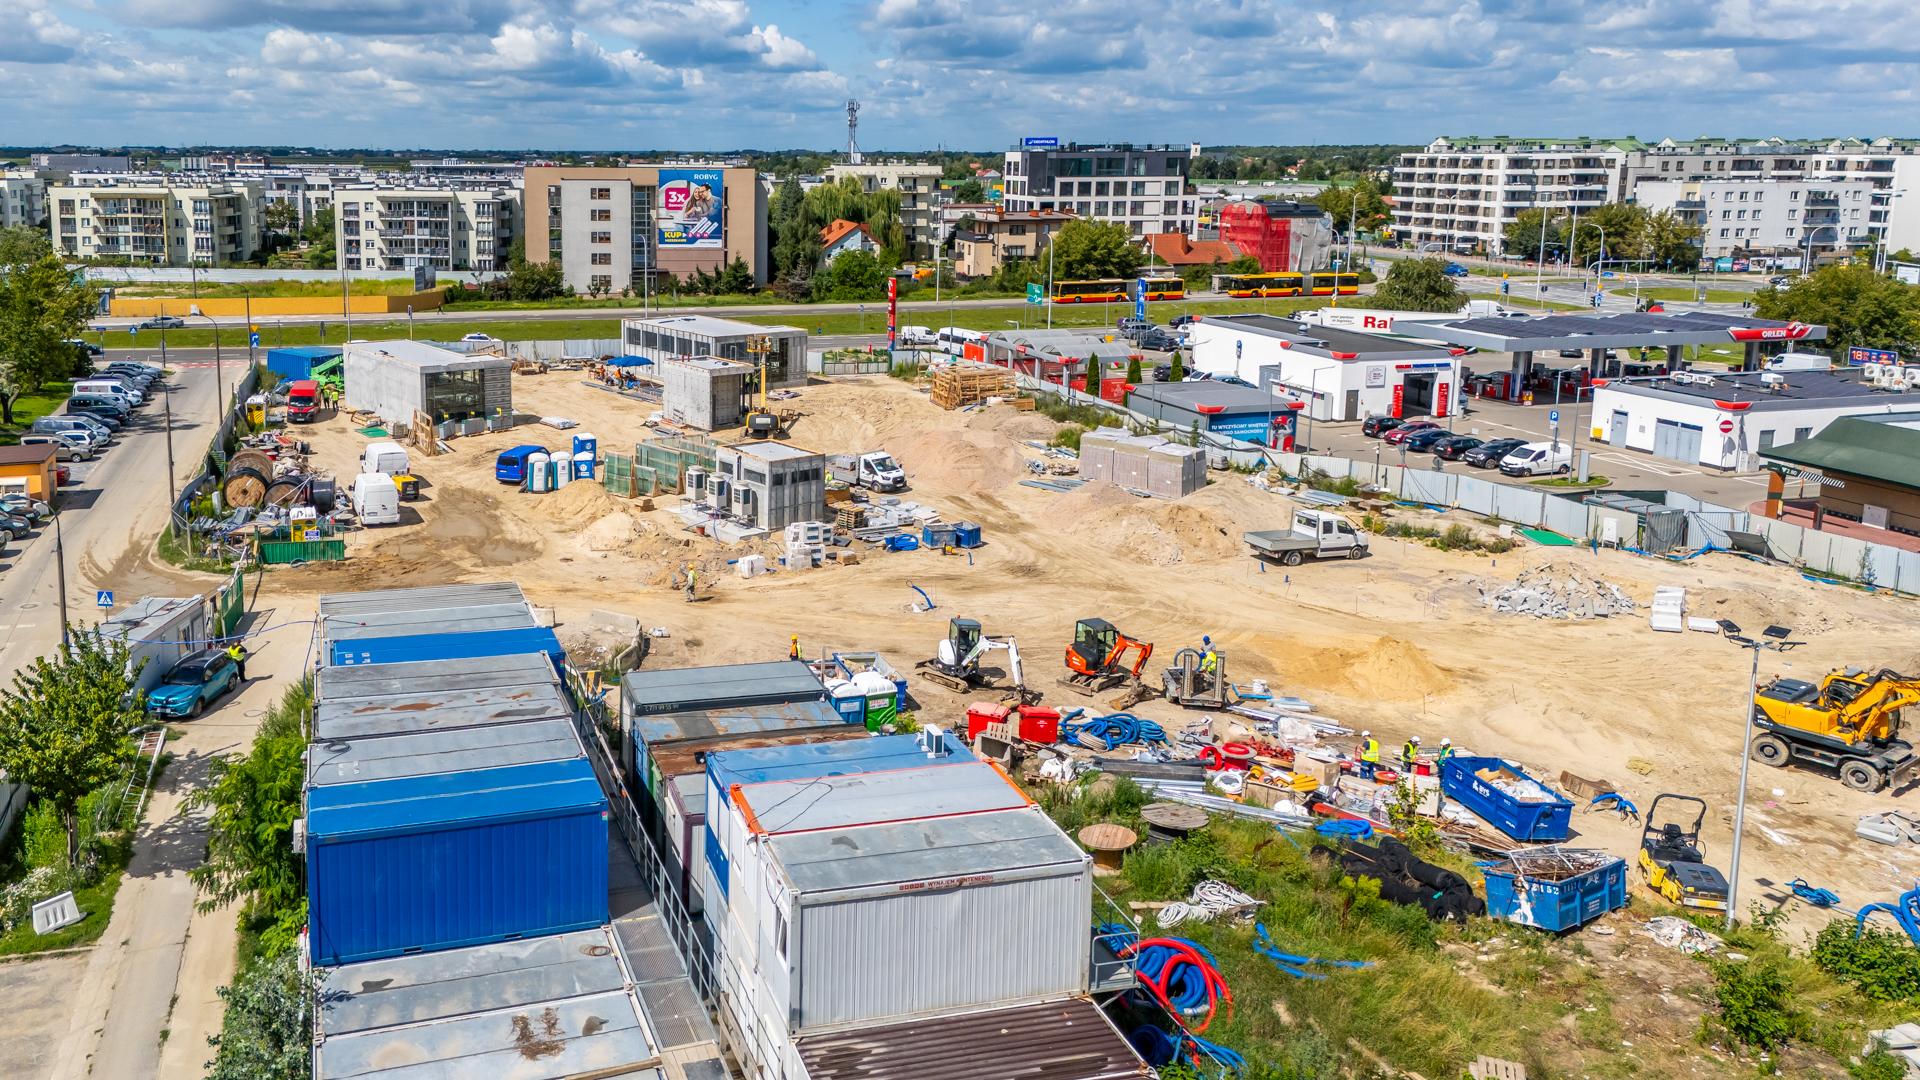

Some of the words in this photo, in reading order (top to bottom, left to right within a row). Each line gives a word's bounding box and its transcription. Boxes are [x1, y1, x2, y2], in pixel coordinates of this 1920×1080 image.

[668, 191, 686, 203] 3x
[664, 231, 682, 239] KUP
[1761, 330, 1787, 338] ORLEN
[1551, 411, 1558, 420] P
